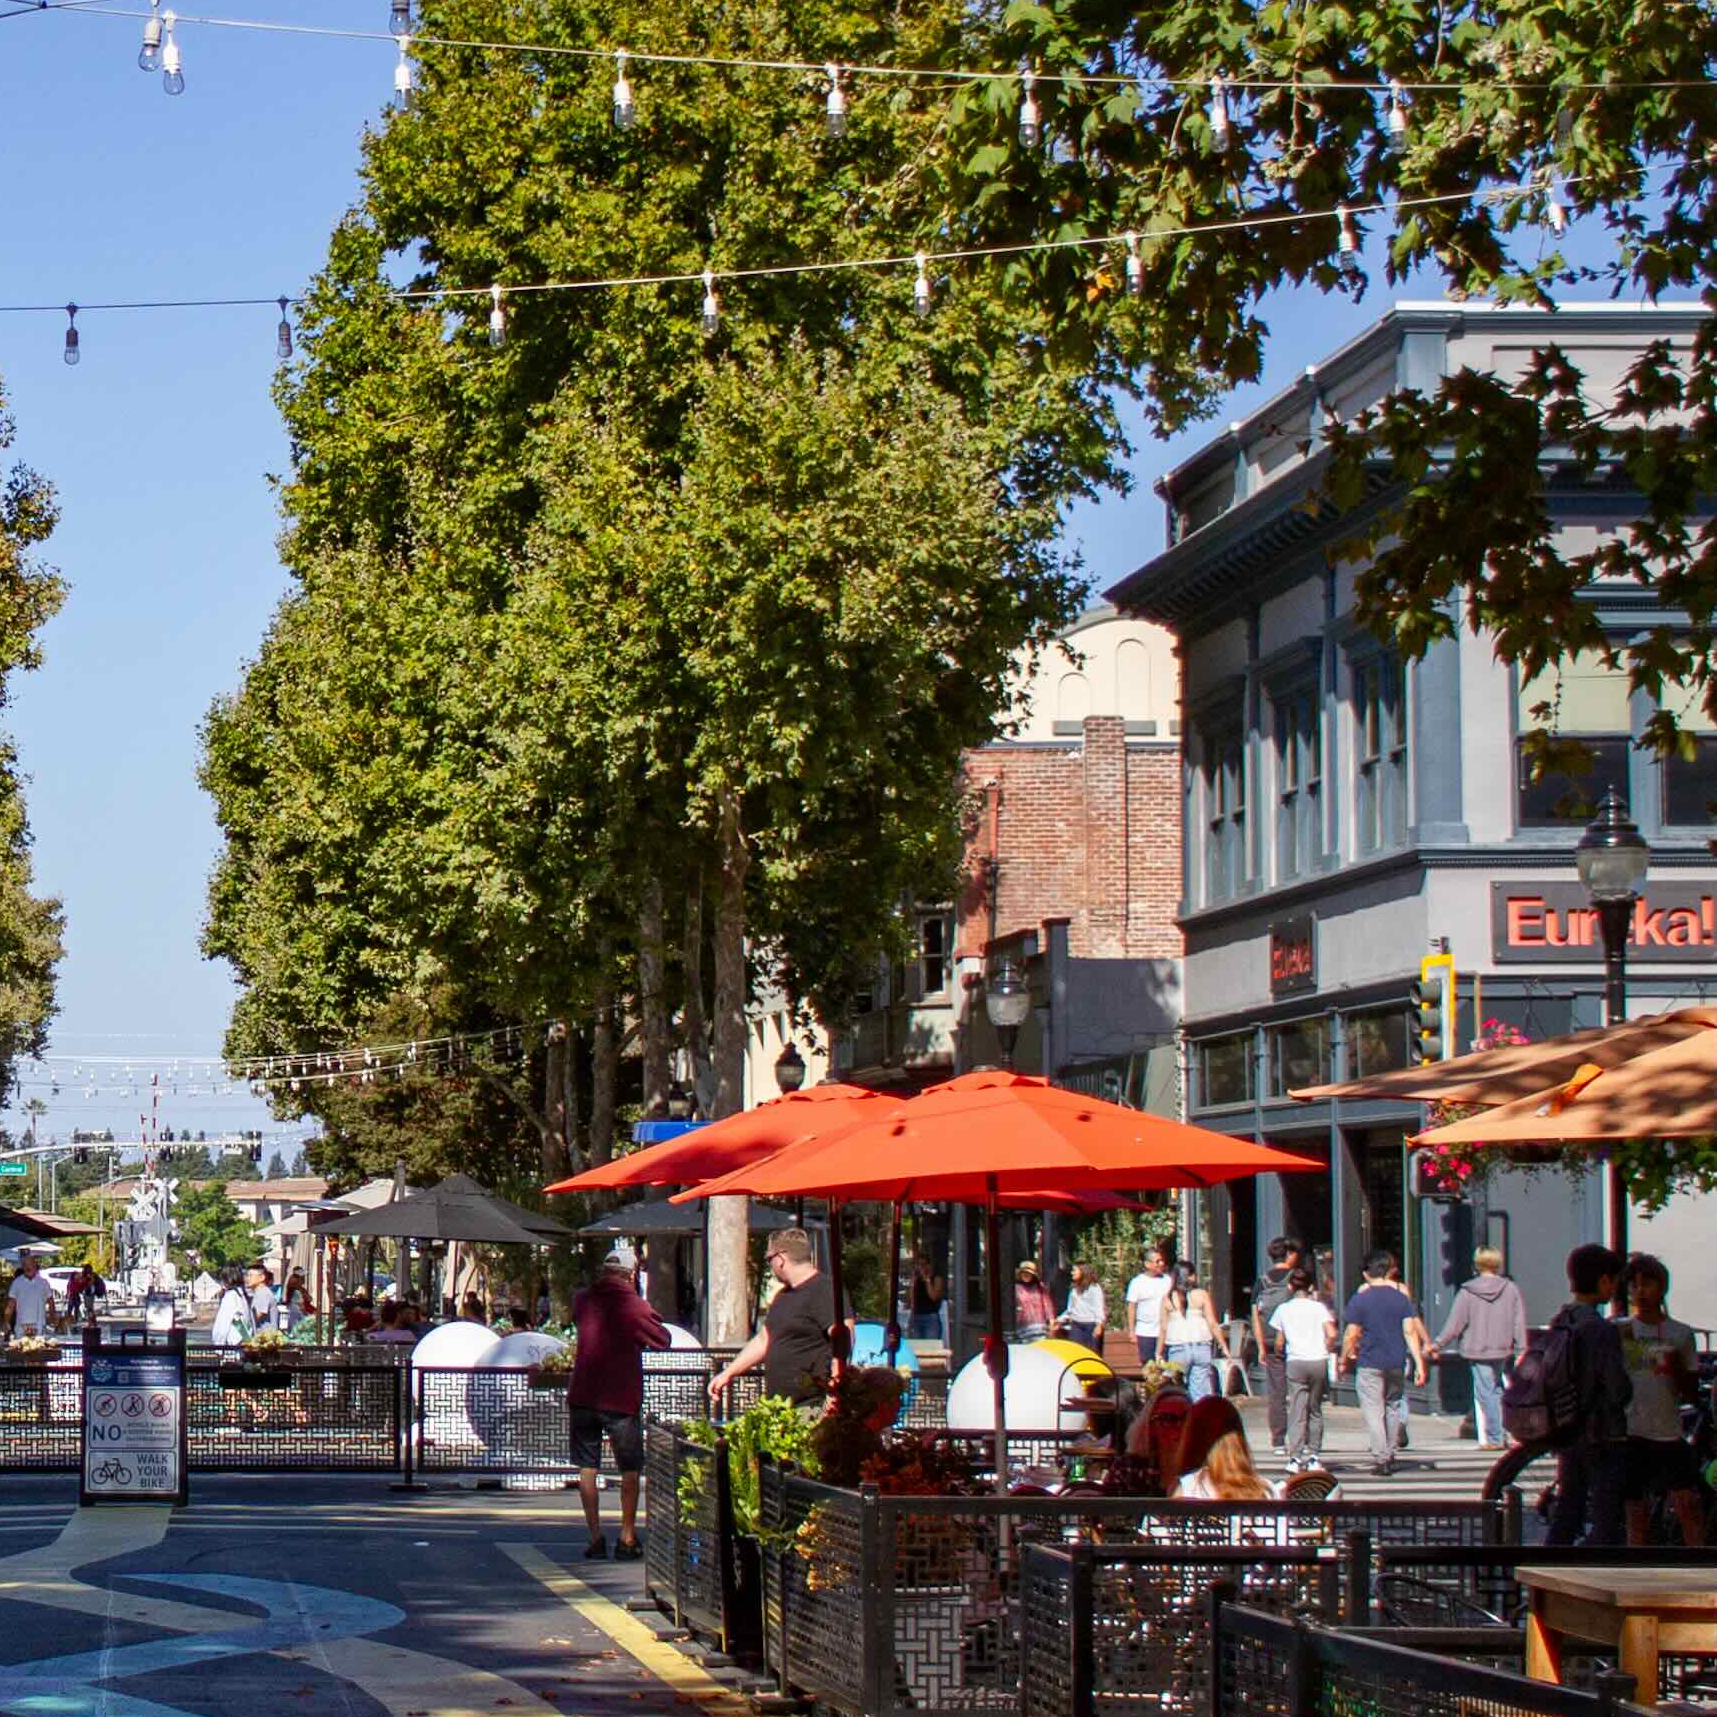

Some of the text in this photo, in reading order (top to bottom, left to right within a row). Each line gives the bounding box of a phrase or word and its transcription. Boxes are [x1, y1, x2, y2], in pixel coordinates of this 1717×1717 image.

[1506, 896, 1716, 946] Eurka!
[92, 1425, 121, 1441] NO
[136, 1454, 168, 1465] WALK
[136, 1466, 168, 1477] YOUR
[139, 1478, 164, 1488] BIKE
